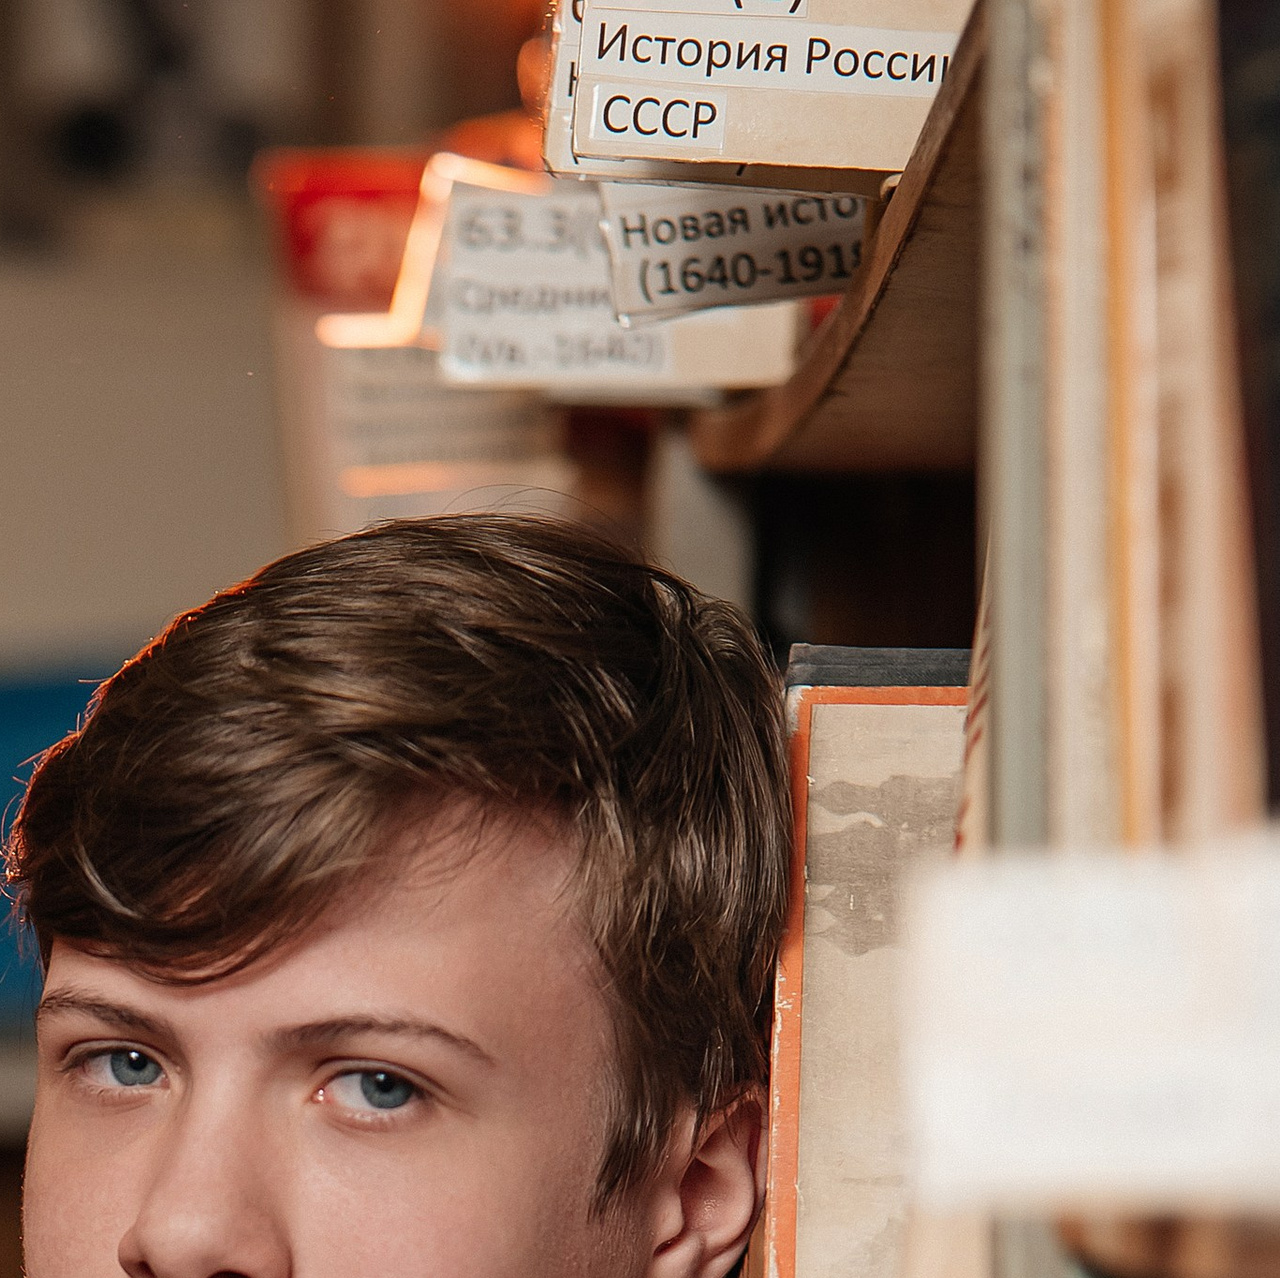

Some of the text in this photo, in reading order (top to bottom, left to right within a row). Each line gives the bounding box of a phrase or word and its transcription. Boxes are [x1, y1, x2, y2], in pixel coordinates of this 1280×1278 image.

[596, 21, 952, 85] История Росси
[601, 94, 718, 139] СССР
[619, 206, 751, 249] Новая
